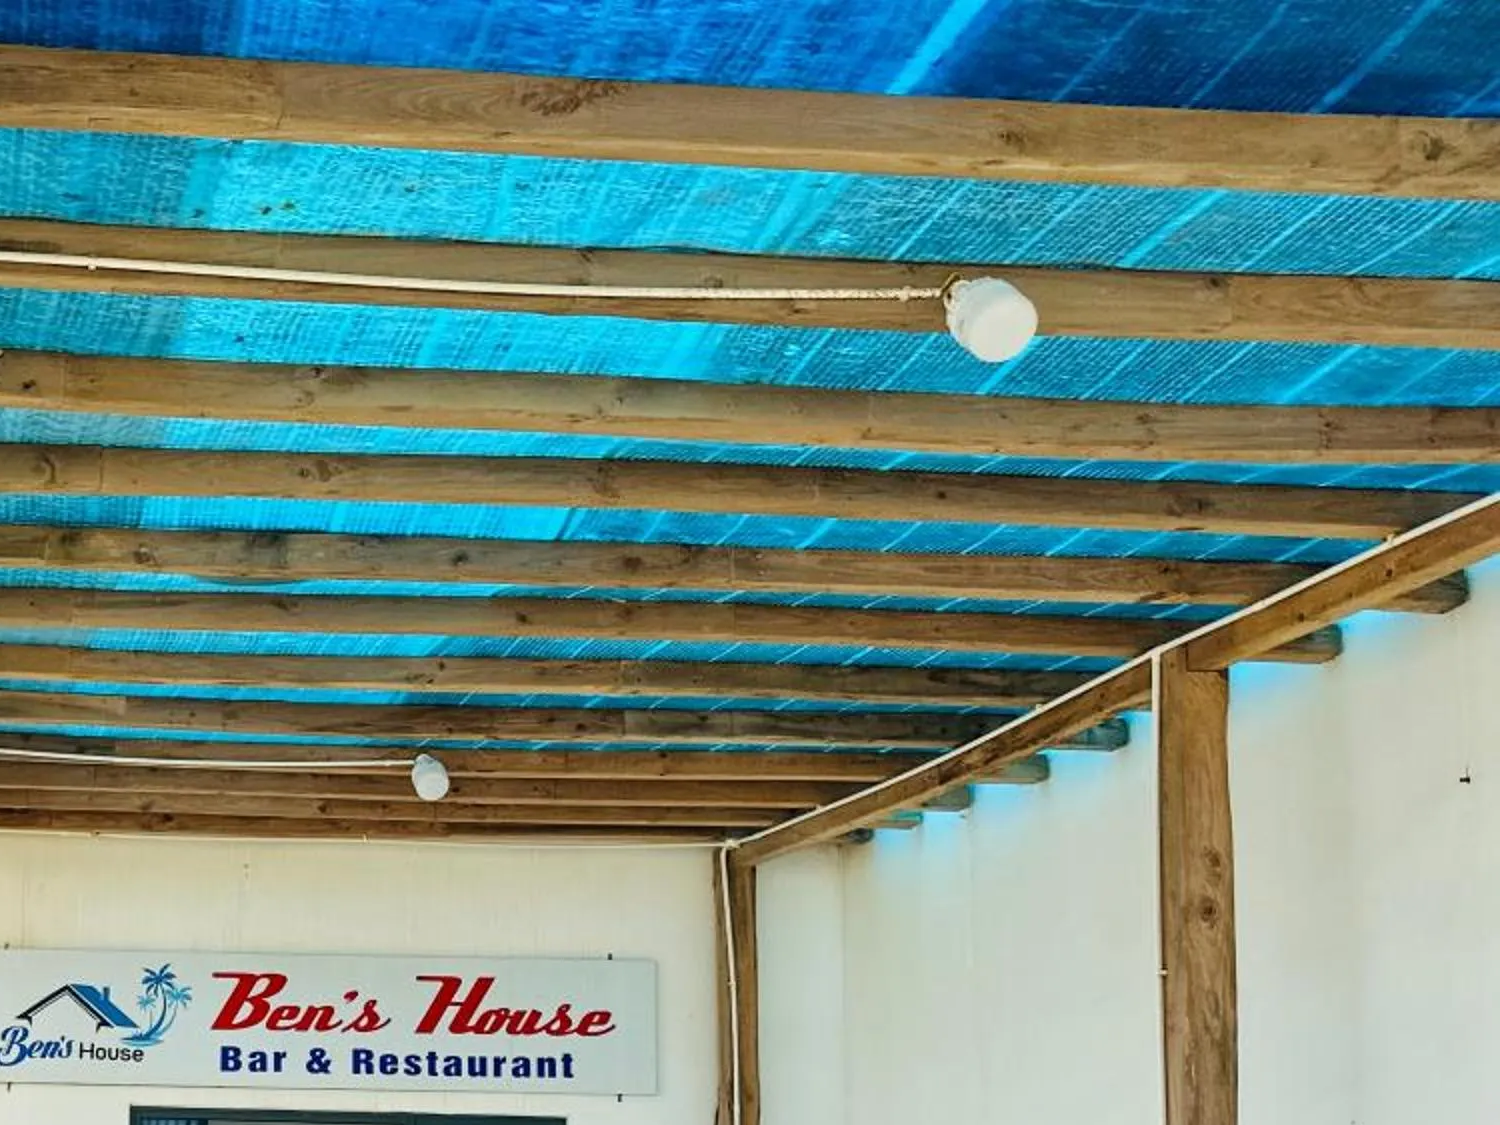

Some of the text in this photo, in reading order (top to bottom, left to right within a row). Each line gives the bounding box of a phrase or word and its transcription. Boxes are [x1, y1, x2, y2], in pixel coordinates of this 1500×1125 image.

[211, 972, 616, 1036] Ben's House
[79, 1041, 145, 1063] House
[220, 1045, 575, 1079] Bar & Restaurant
